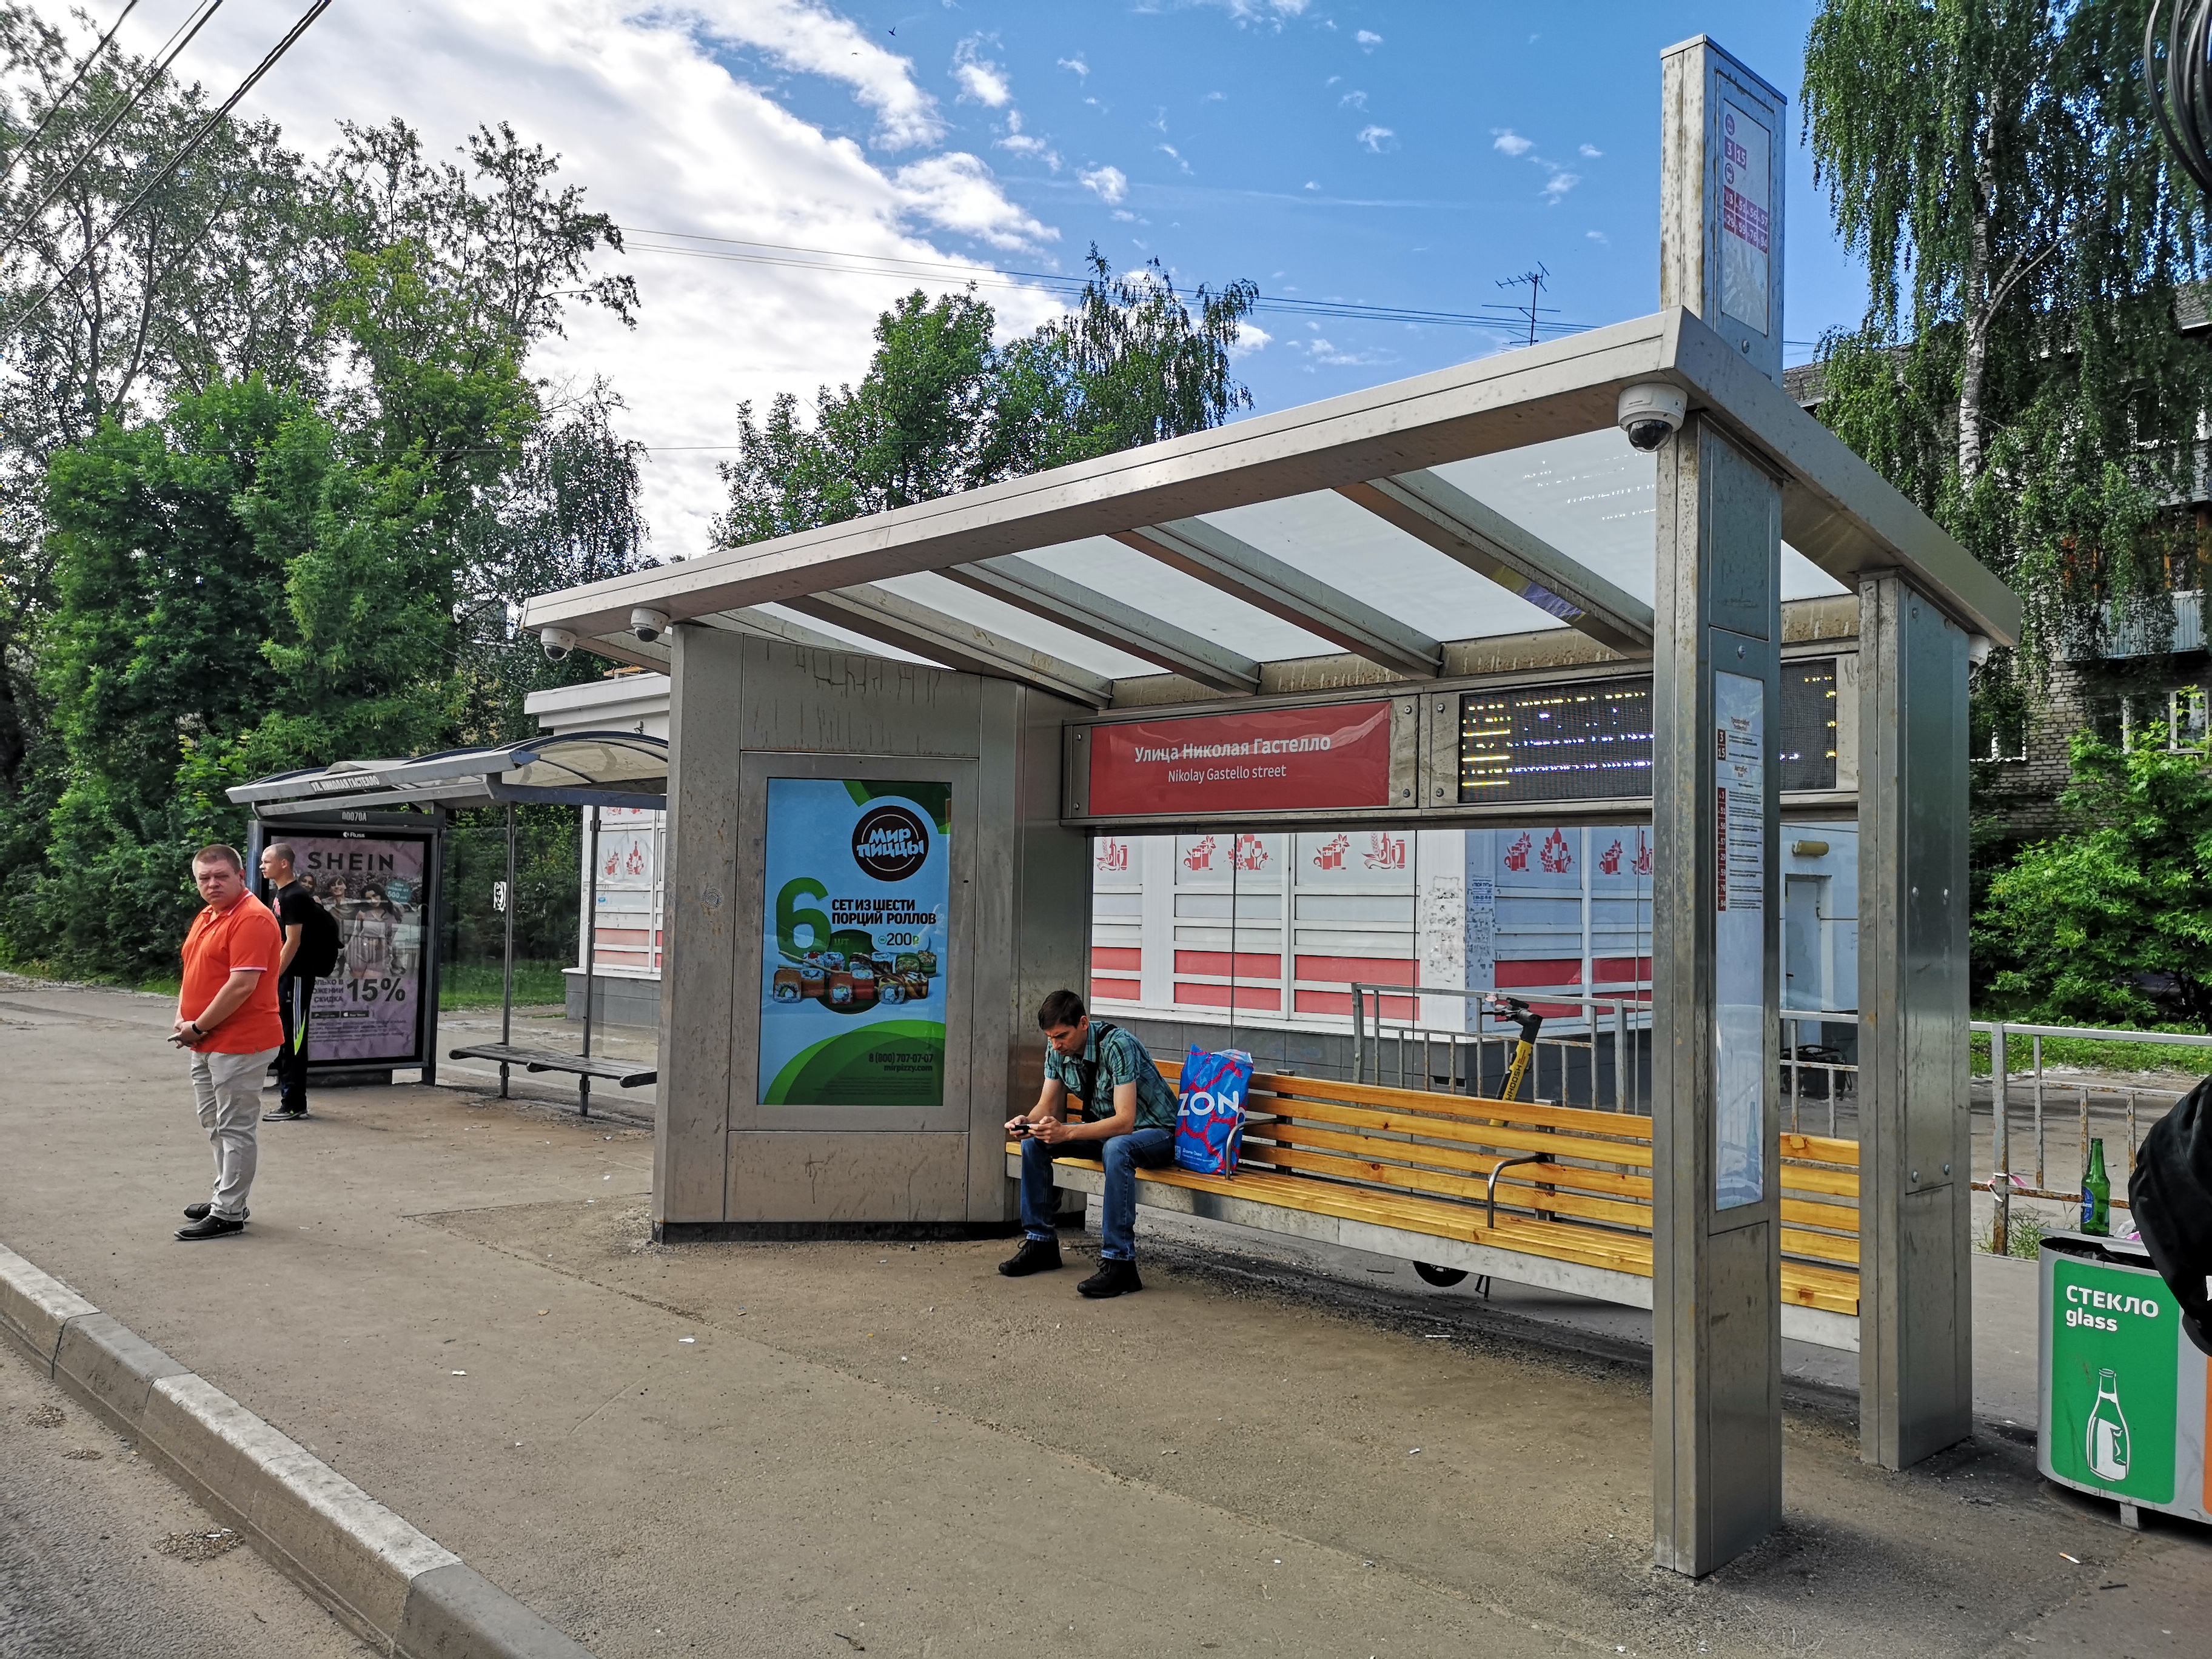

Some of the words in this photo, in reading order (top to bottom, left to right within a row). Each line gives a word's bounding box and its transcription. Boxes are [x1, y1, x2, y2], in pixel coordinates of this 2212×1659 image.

[1727, 141, 1732, 156] 3
[1737, 149, 1746, 166] 15
[1719, 731, 1724, 742] 3
[1134, 746, 1179, 763] Улица
[1182, 742, 1249, 759] Николая
[1254, 736, 1331, 755] Гастелло
[1718, 747, 1725, 758] 15
[320, 778, 351, 791] НИКОЛАЯ
[347, 775, 381, 788] ГАСТЕЛЛО
[1168, 769, 1205, 784] Nikolay
[1207, 766, 1250, 780] Gastello
[1252, 765, 1287, 779] street
[307, 851, 394, 871] SHEIN
[832, 899, 854, 911] СЕТ
[855, 899, 871, 911] ИЗ
[873, 899, 915, 911] ШЕСТИ
[776, 877, 831, 963] 6
[832, 911, 883, 927] ПОРЦИЙ
[886, 913, 936, 925] РОЛЛОВ
[347, 977, 406, 1002] 15%
[869, 1053, 874, 1062] 8
[876, 1052, 895, 1064] (800)
[896, 1053, 934, 1063] 707-07-07
[883, 1063, 933, 1073] mirpizzy.com
[1506, 1064, 1522, 1101] WHOOSH
[2066, 1284, 2159, 1318] СТЕКЛО
[2065, 1307, 2118, 1332] glass
